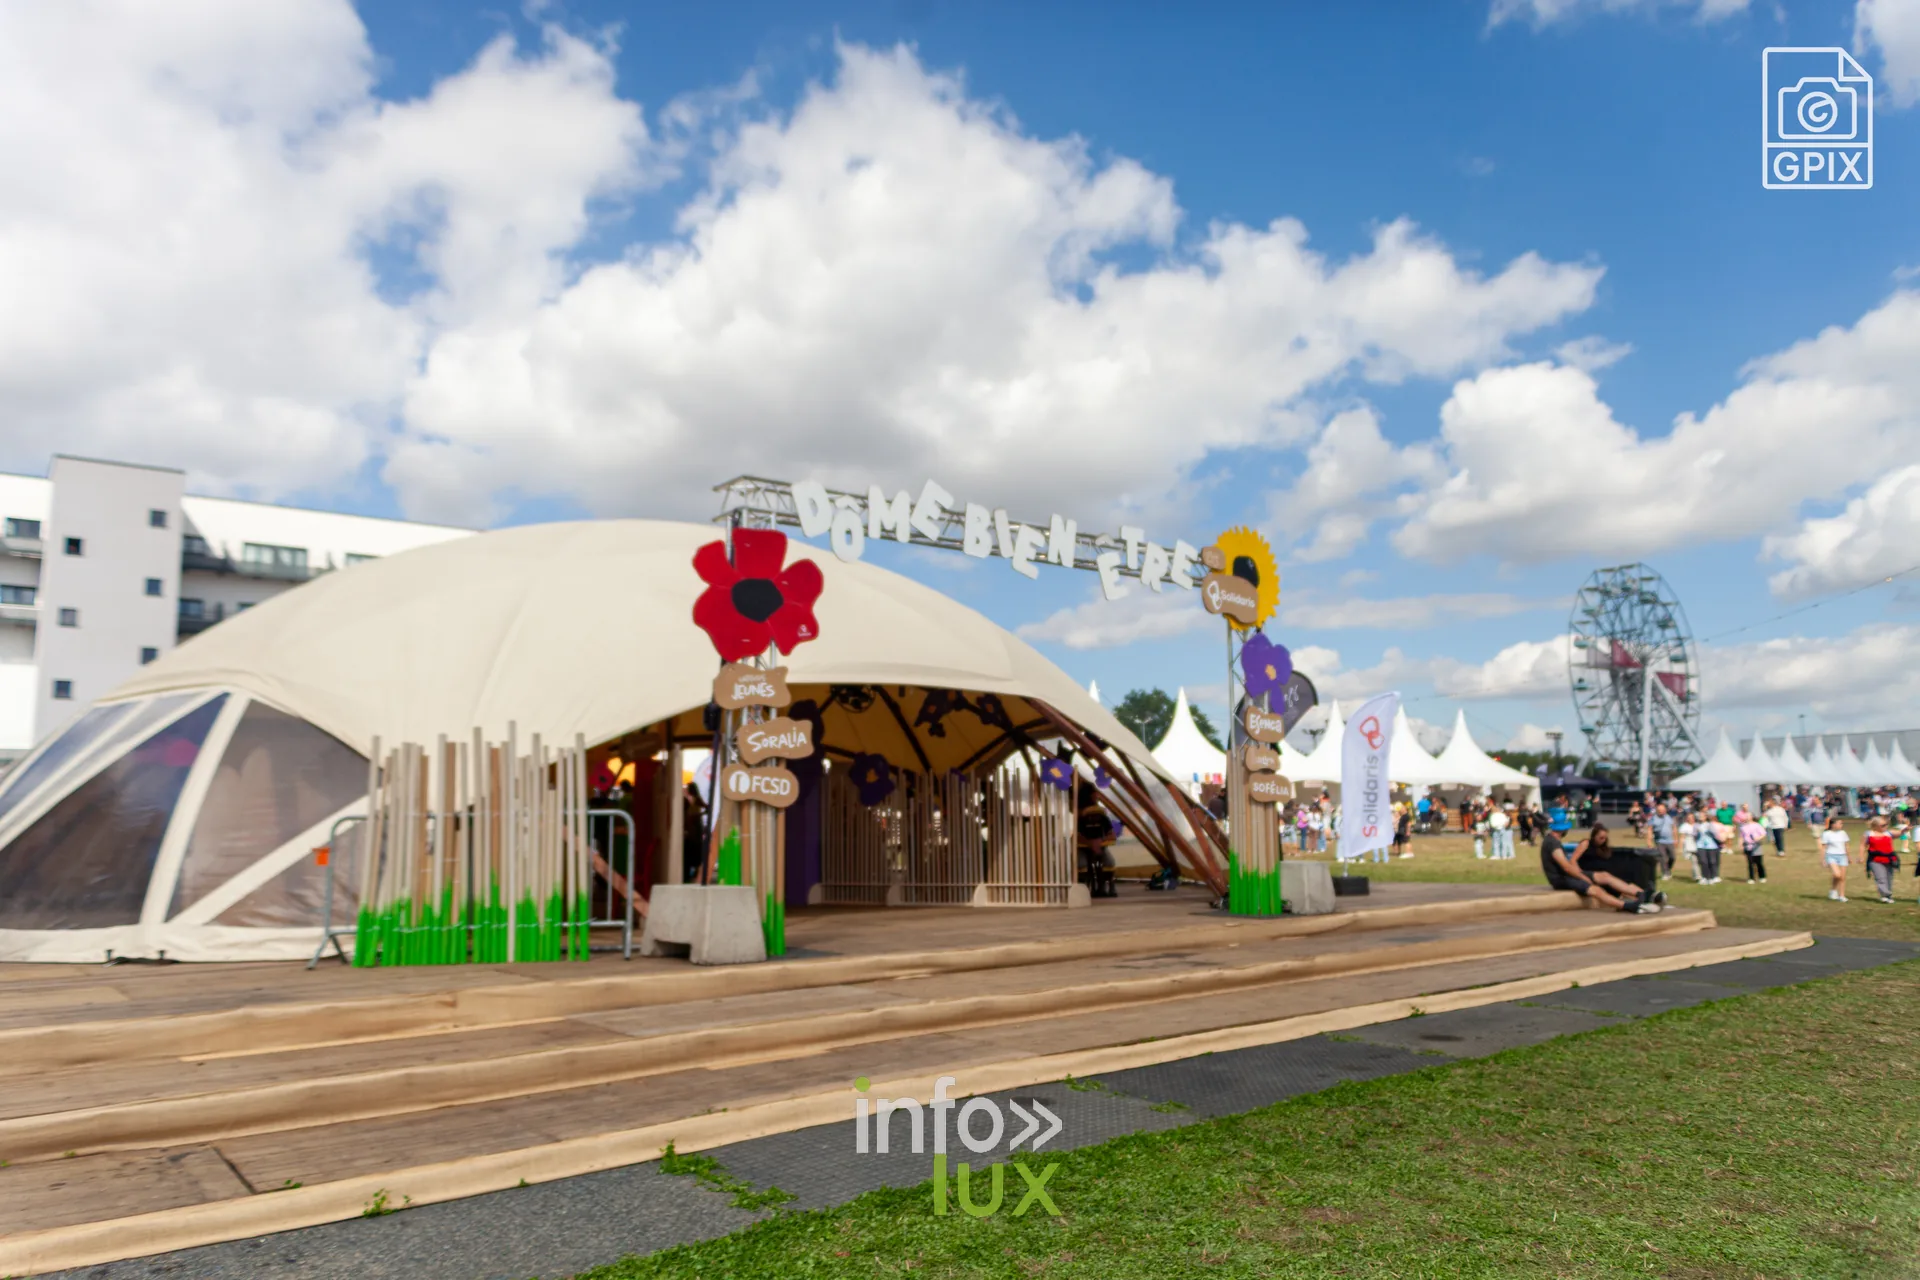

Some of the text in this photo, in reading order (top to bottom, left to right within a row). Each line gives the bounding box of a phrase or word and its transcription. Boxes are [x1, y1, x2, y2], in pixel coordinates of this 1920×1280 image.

[791, 478, 1199, 600] DÔME BIEN ÊTRE
[1220, 589, 1256, 609] Solidaris
[750, 774, 792, 797] FCSD
[1252, 780, 1290, 796] SOFÉLIA
[1362, 754, 1380, 838] Solidaris
